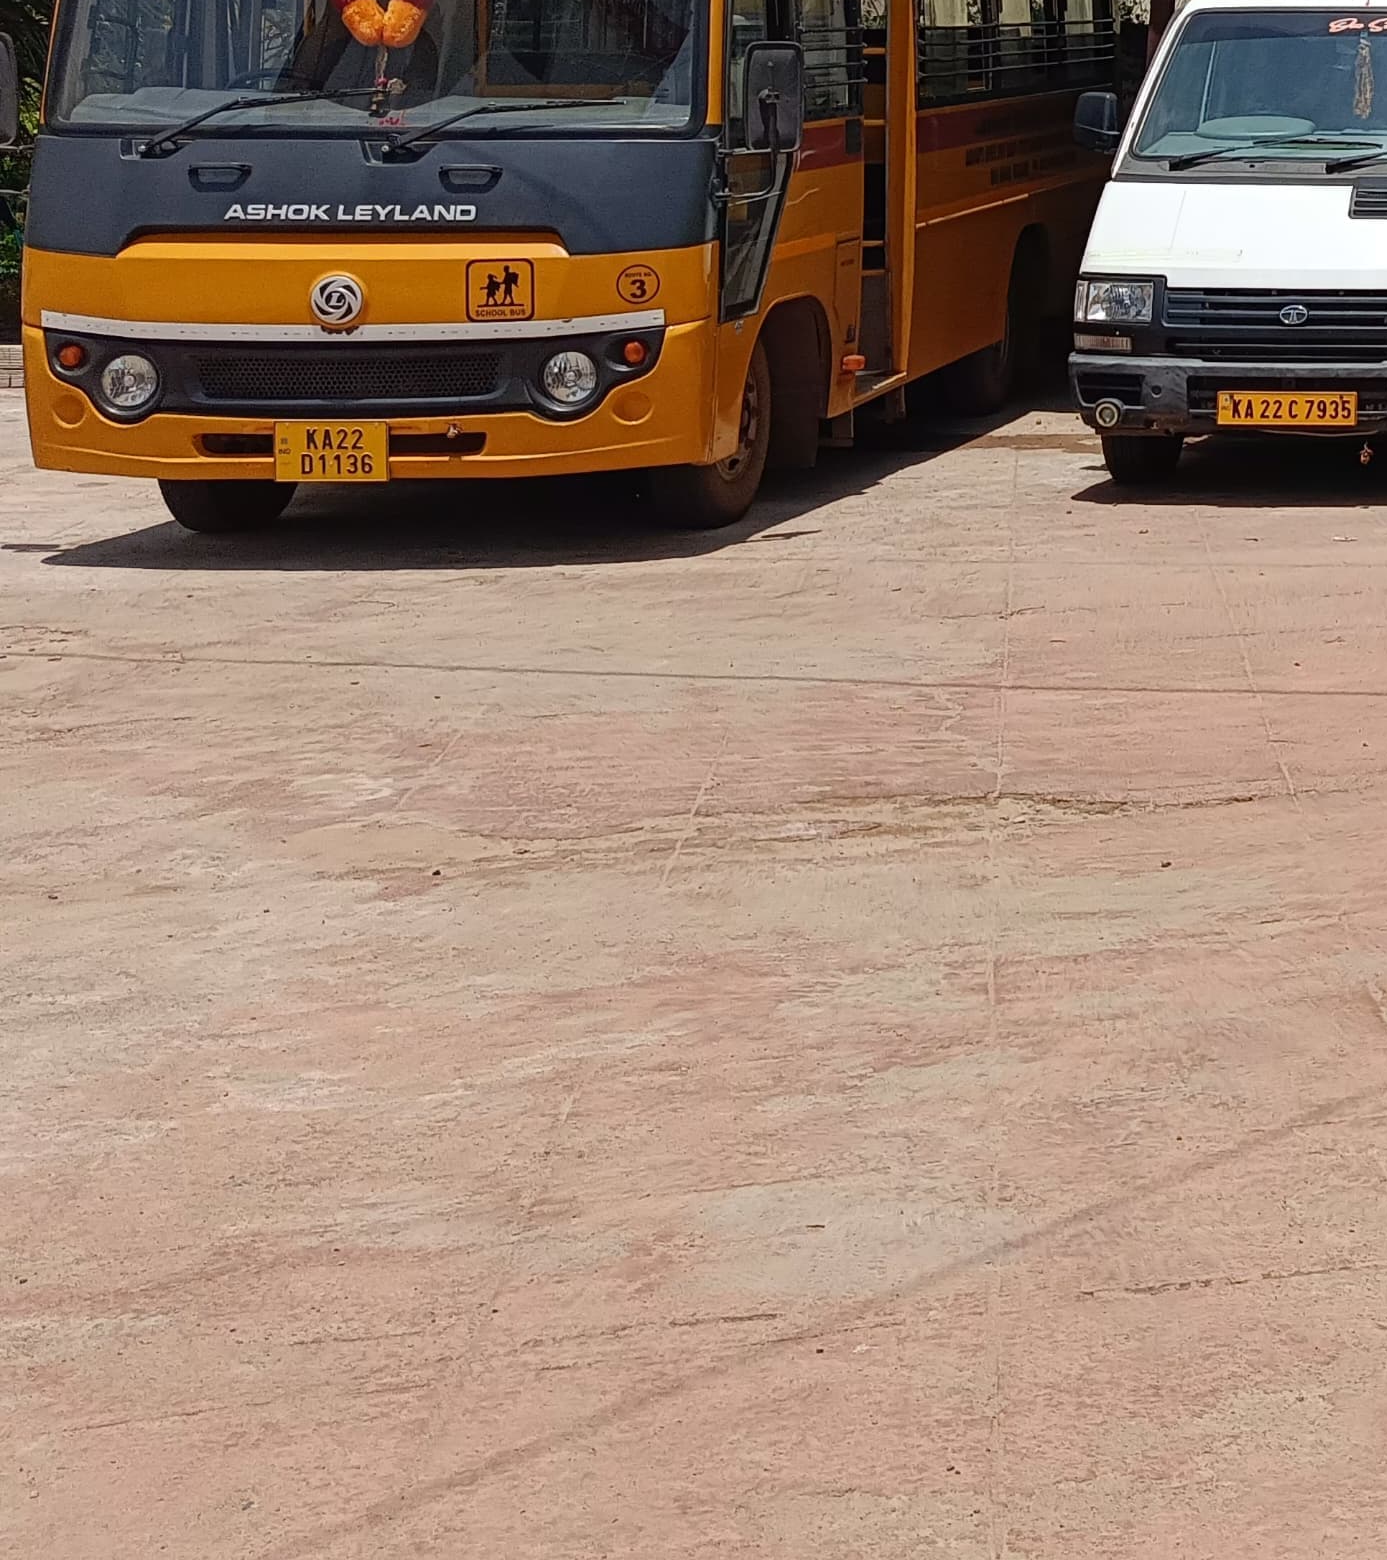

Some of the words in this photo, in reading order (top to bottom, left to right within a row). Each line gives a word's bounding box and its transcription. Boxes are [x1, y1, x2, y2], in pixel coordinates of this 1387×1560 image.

[224, 204, 330, 221] ASHOK
[337, 204, 477, 222] LEYLAND
[630, 279, 647, 299] 3
[475, 308, 506, 318] SCHOOL
[510, 308, 526, 317] BUS
[1231, 399, 1254, 419] KA
[1260, 399, 1283, 419] 22
[1288, 399, 1298, 419] C
[1305, 399, 1351, 419] 7935
[306, 428, 364, 450] KA22
[301, 453, 373, 475] D1136
